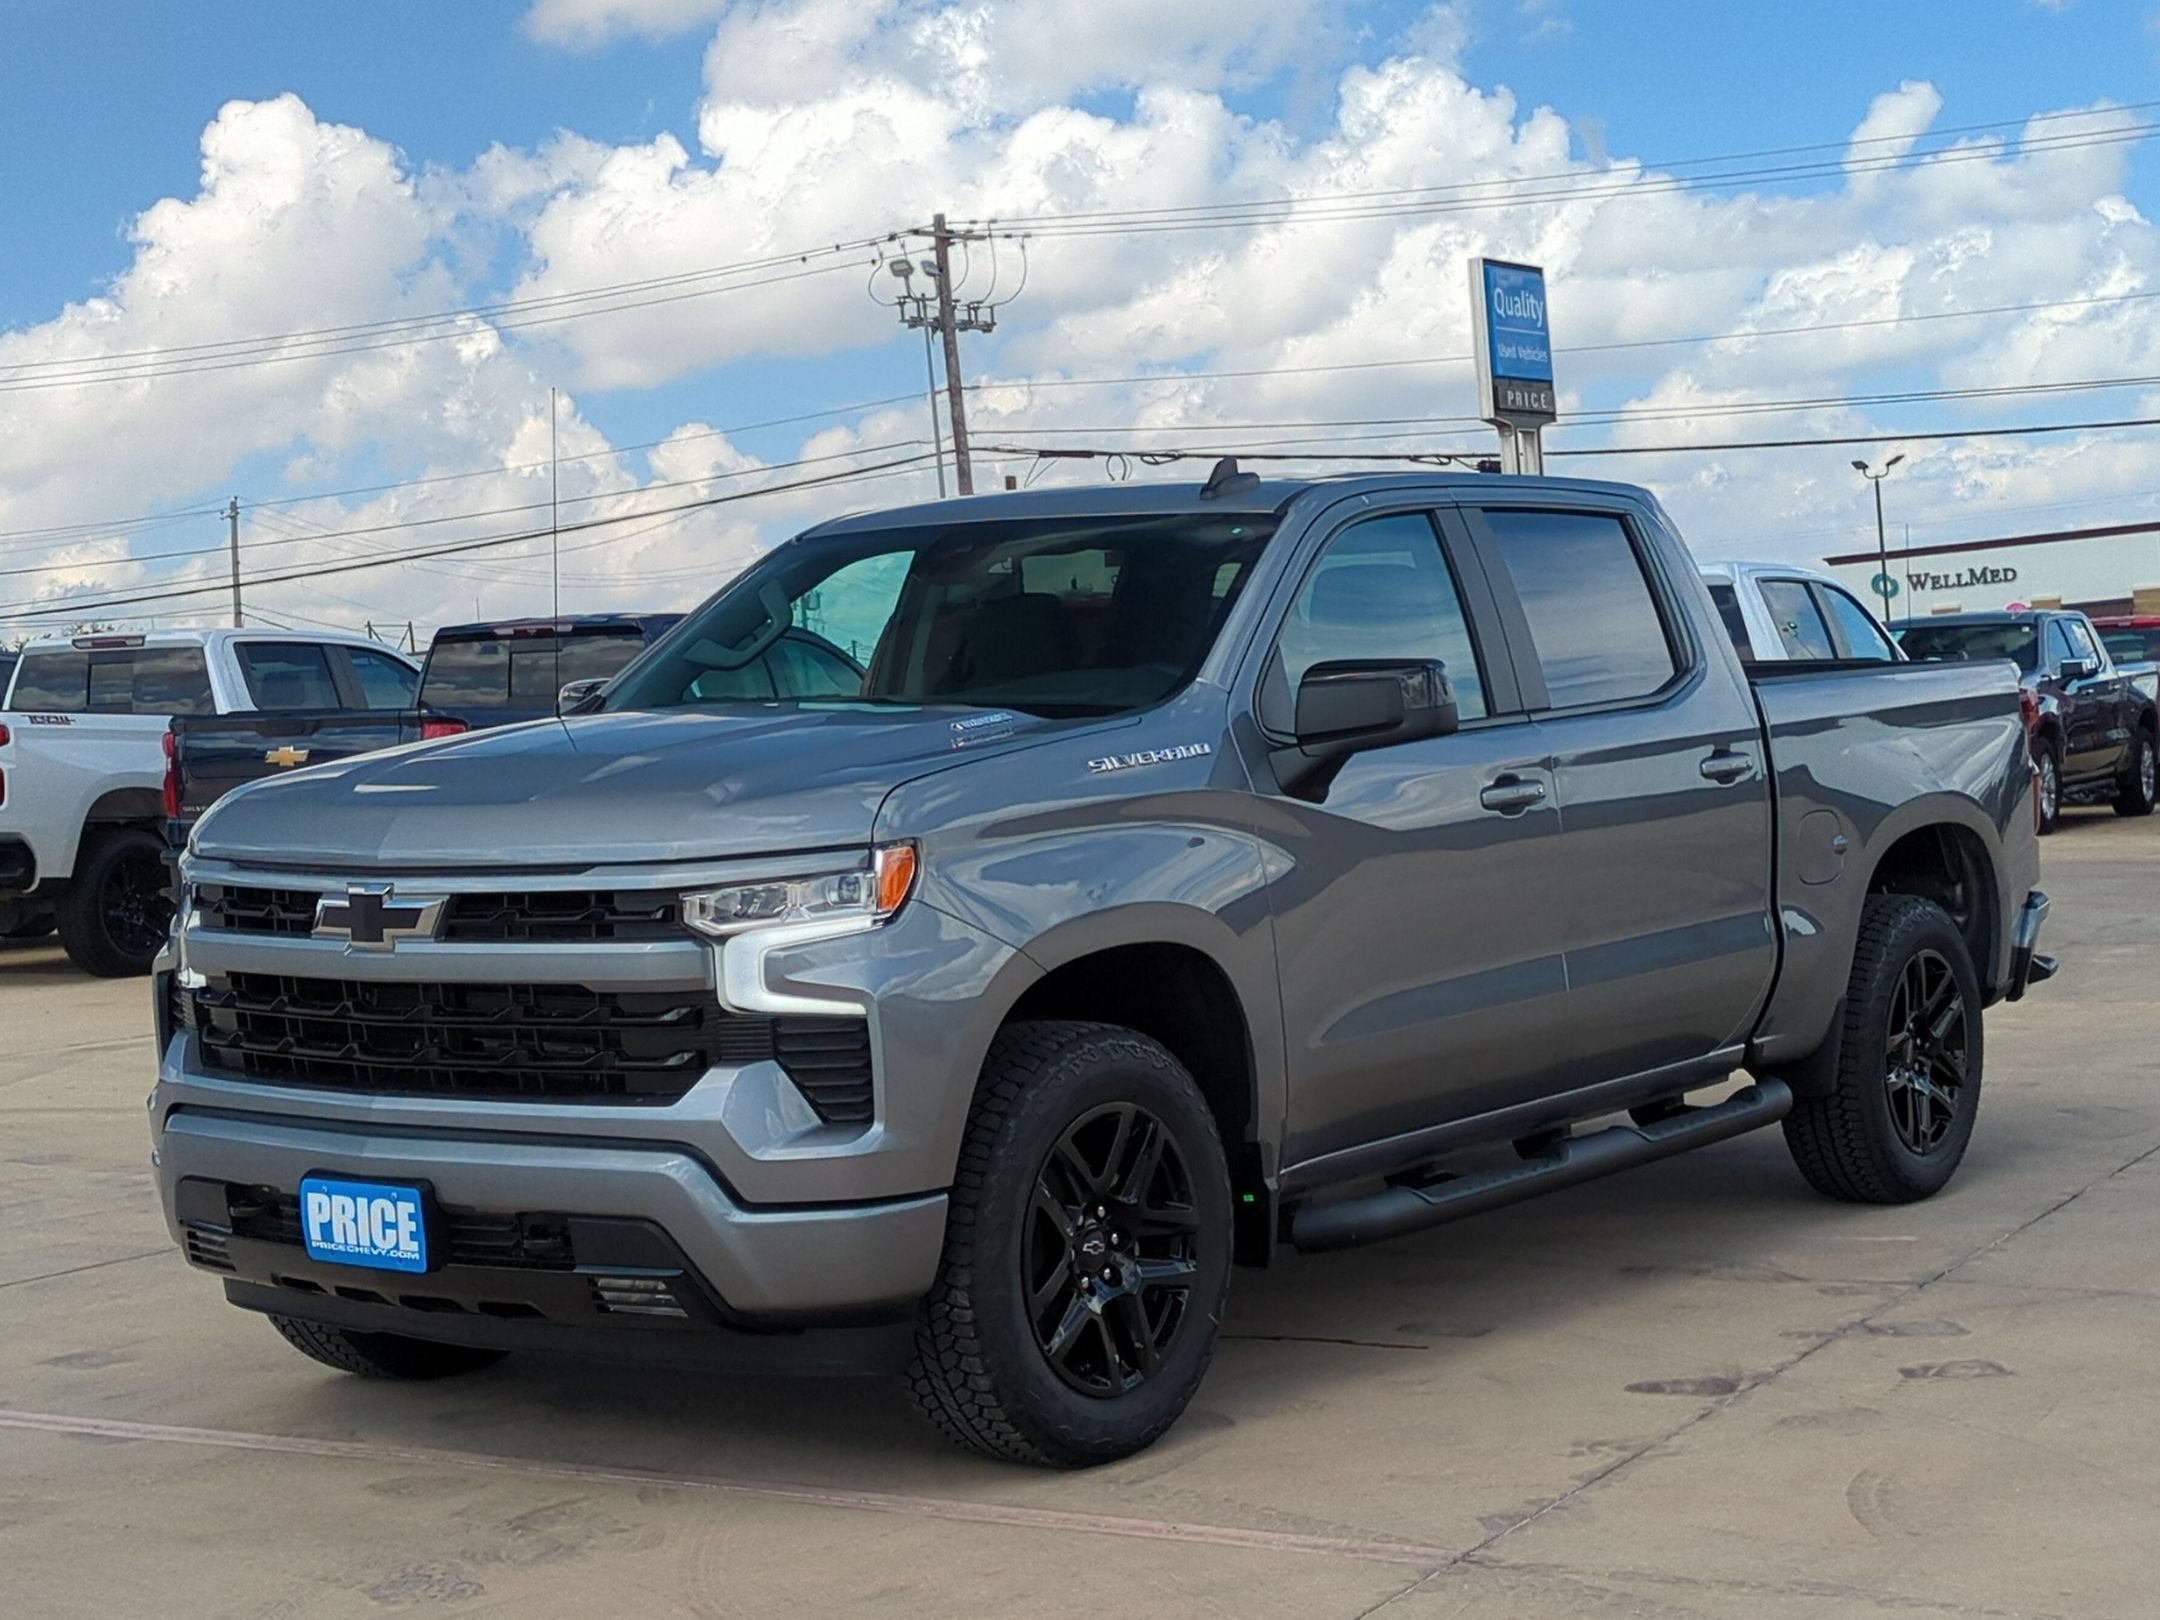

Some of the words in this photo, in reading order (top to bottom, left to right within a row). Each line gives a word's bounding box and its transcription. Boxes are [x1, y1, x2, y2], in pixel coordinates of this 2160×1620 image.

[1494, 288, 1544, 328] Quality
[1507, 390, 1548, 409] PRICE
[1087, 742, 1211, 774] SILVERADO
[307, 1192, 419, 1252] PRICE
[311, 1240, 420, 1261] PRICECHEVY.COM
